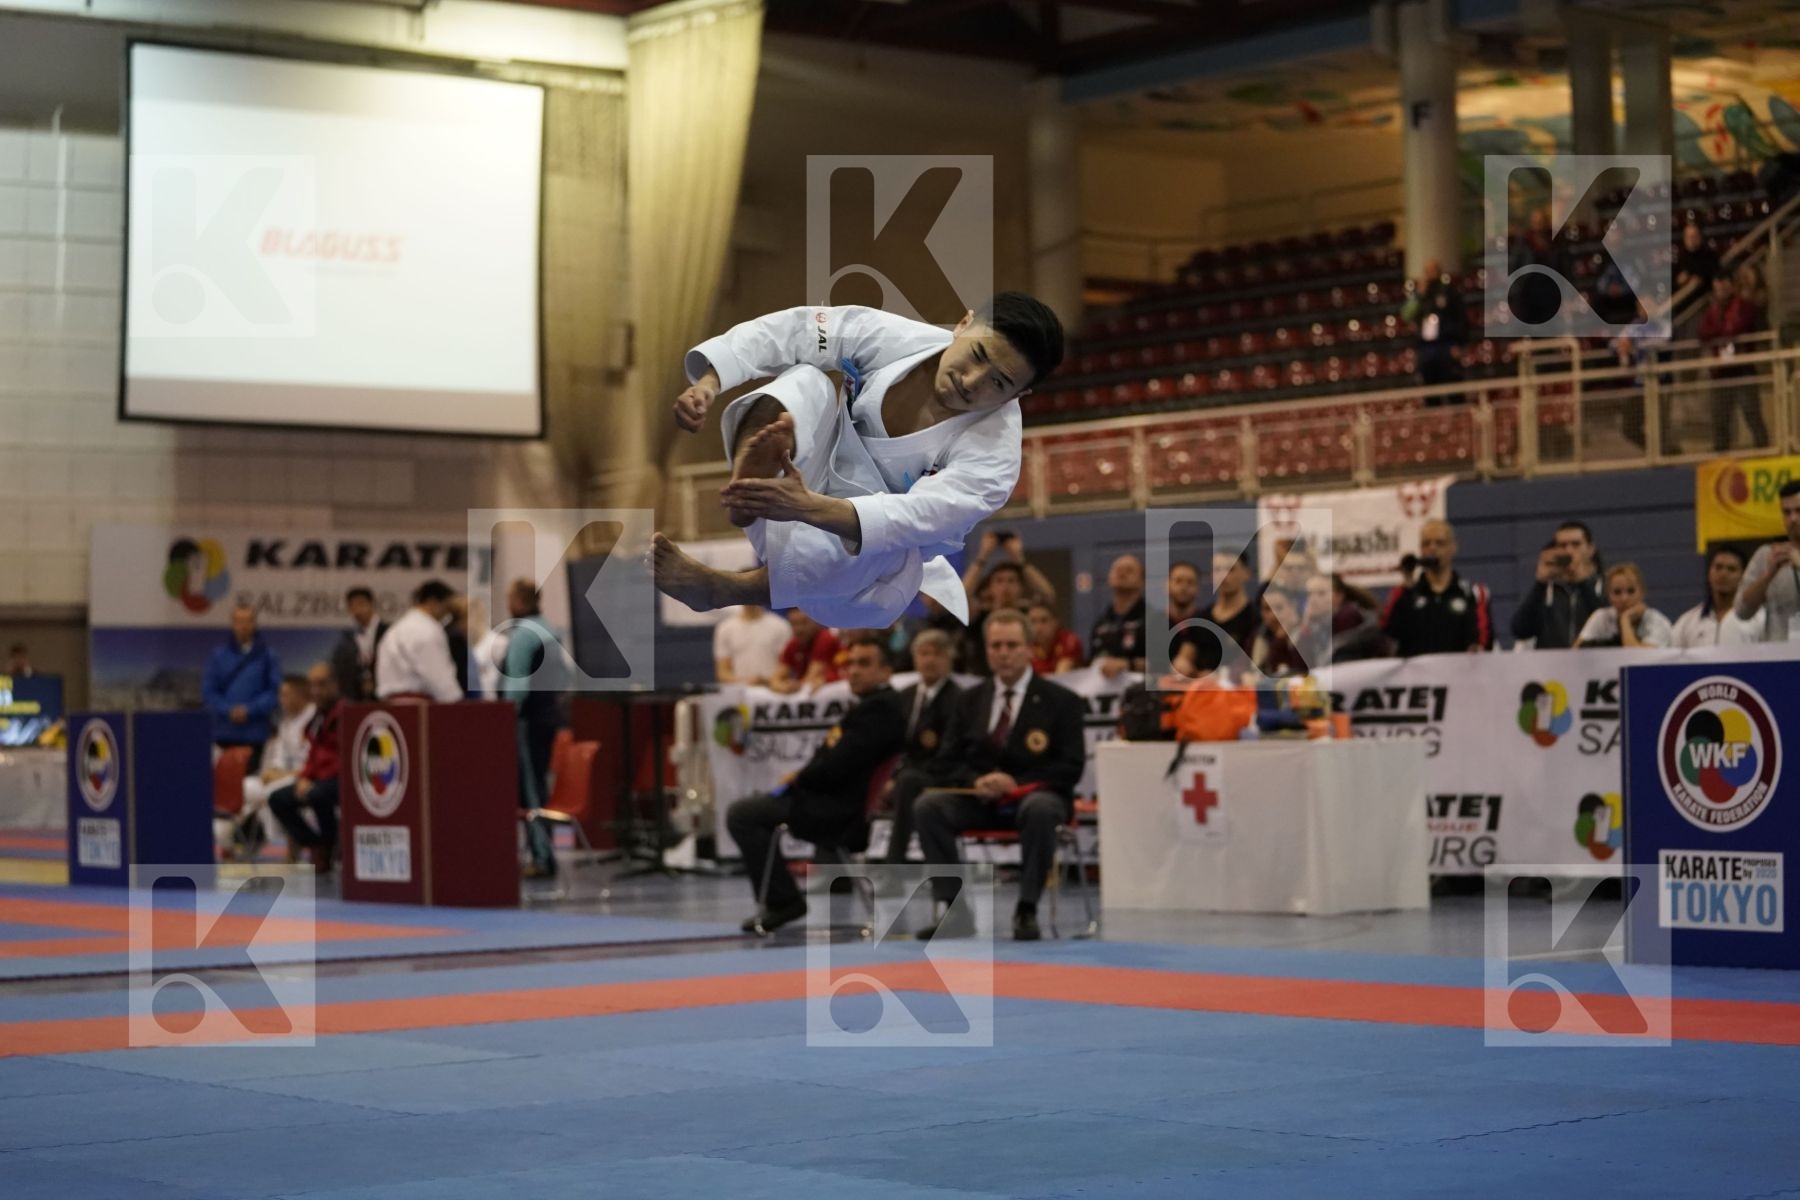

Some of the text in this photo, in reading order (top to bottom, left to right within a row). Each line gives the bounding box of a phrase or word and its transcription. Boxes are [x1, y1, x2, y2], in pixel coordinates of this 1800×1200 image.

[817, 326, 828, 353] JAL
[1697, 684, 1739, 702] WORLD
[1689, 742, 1746, 769] WKF
[1672, 781, 1769, 824] KARATE FEDERATION
[1665, 855, 1742, 881] KARATE
[1666, 881, 1777, 926] TOKYO
